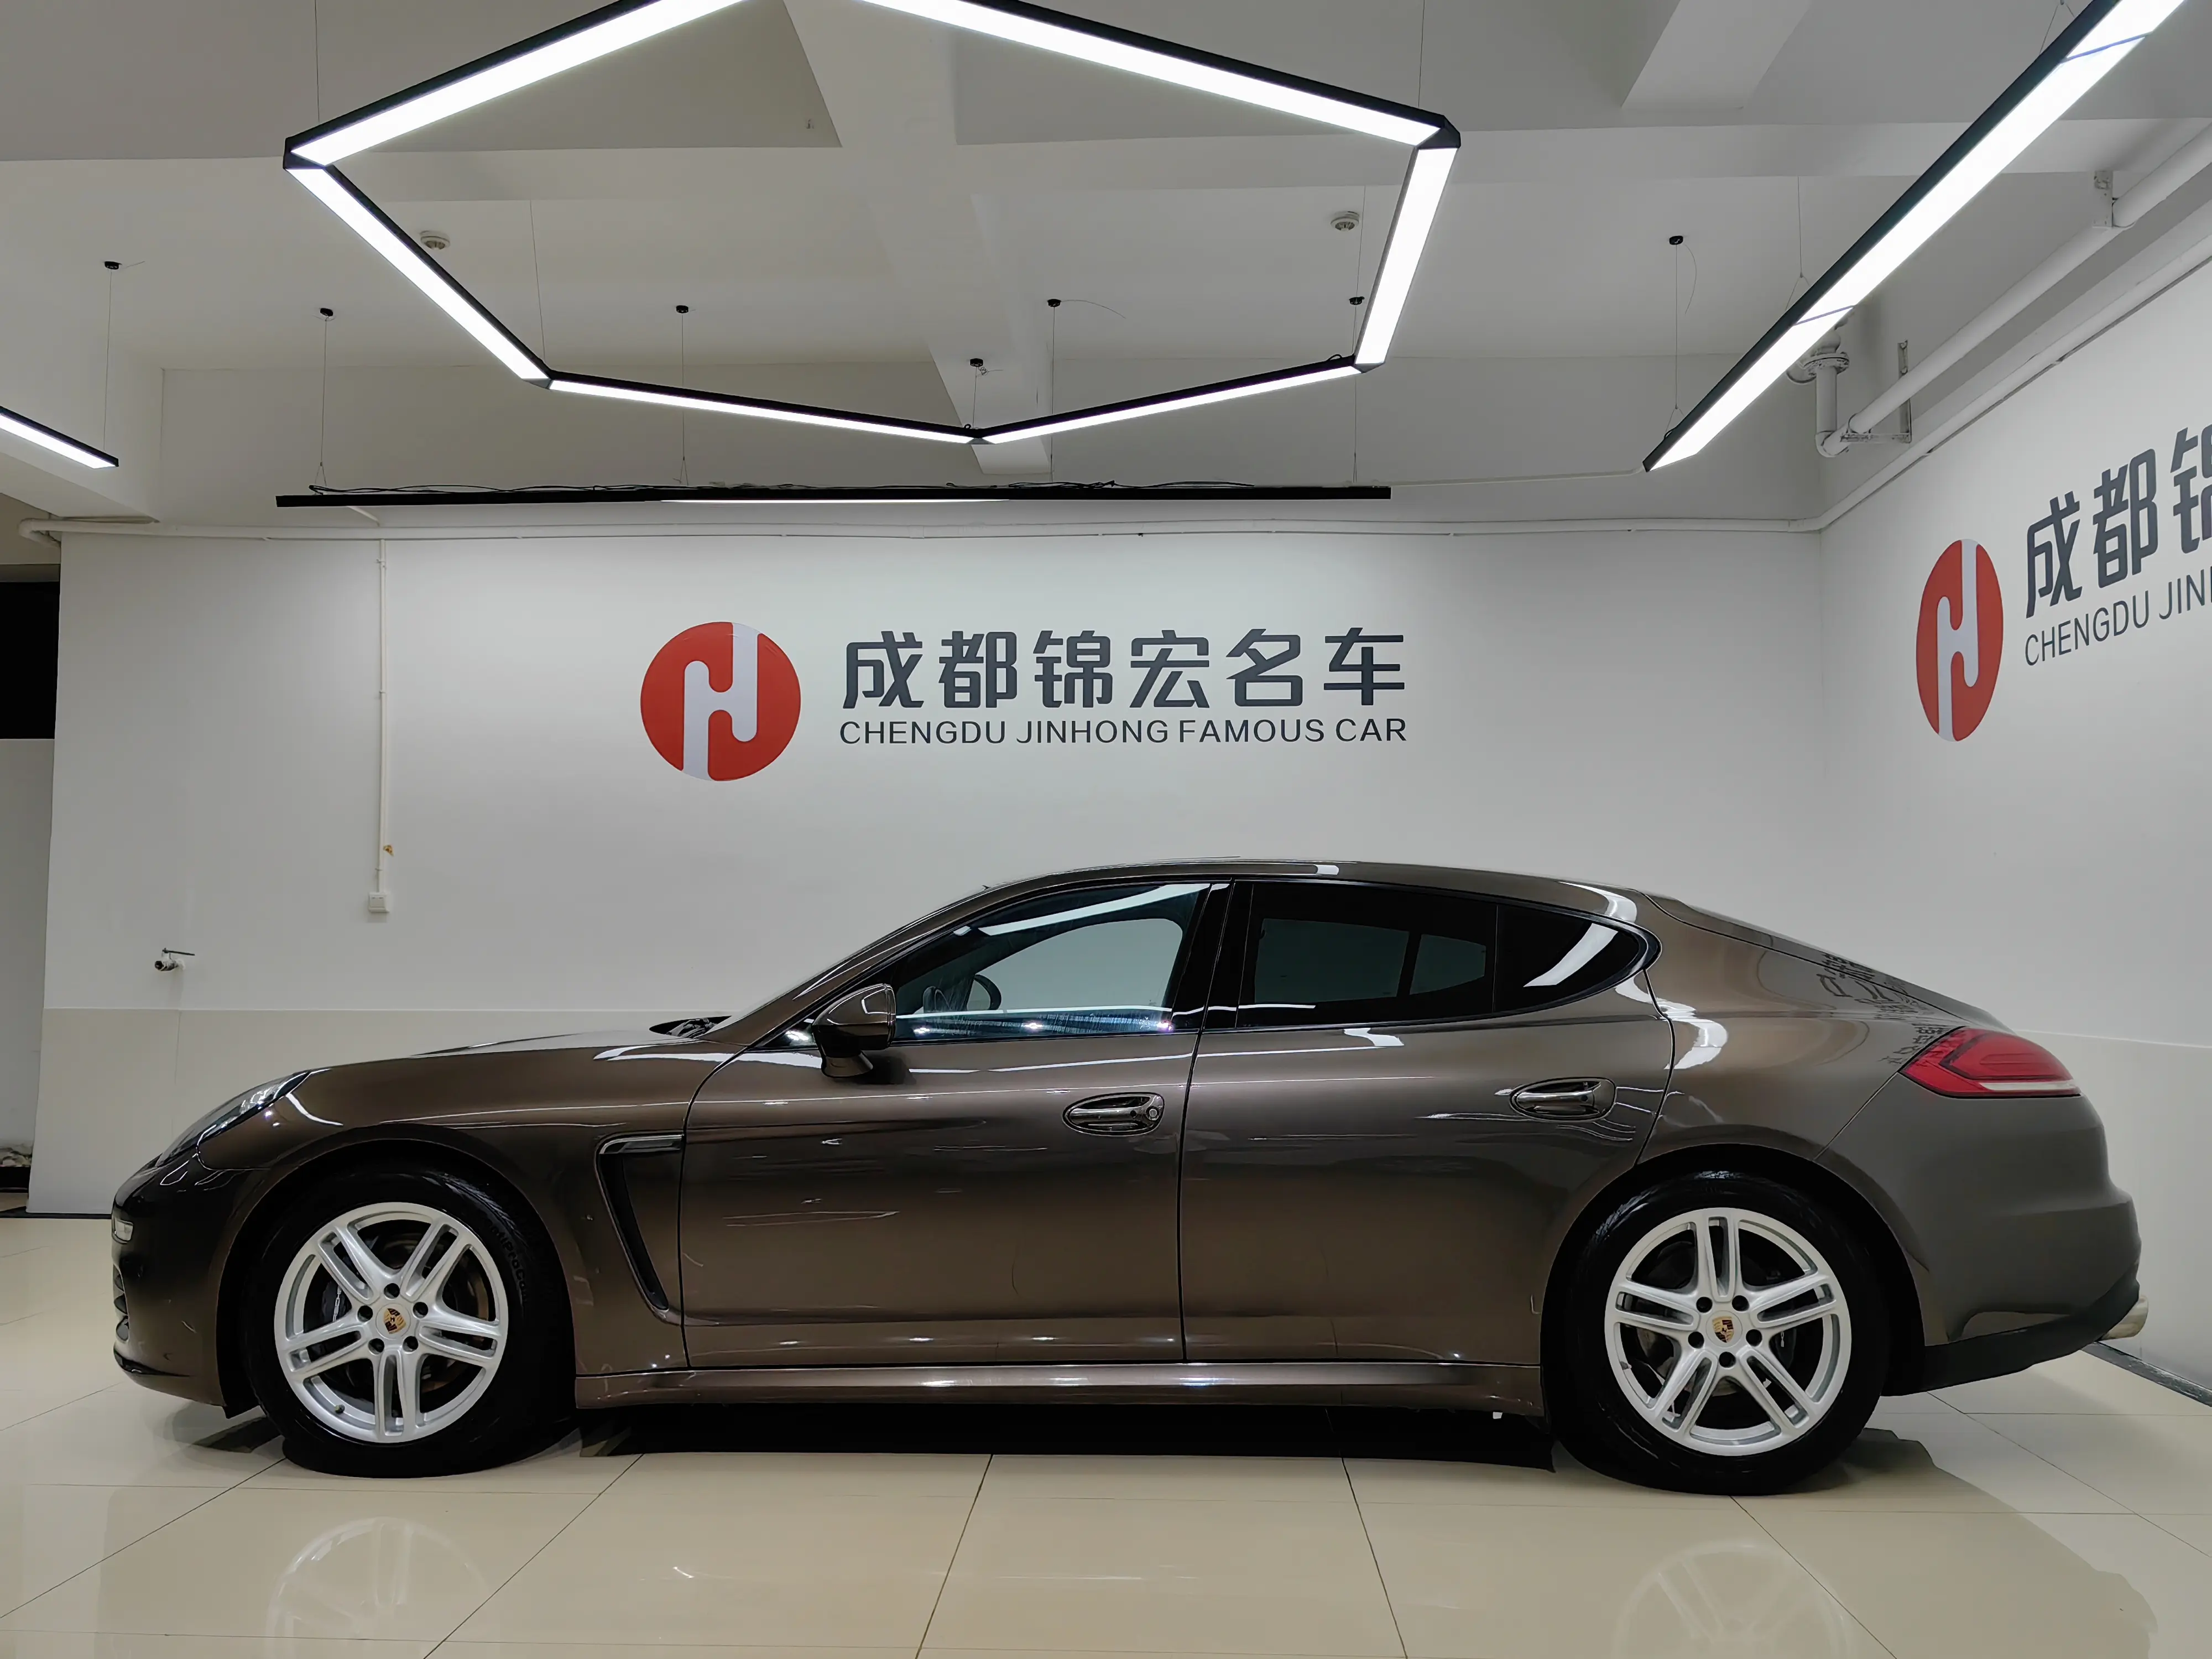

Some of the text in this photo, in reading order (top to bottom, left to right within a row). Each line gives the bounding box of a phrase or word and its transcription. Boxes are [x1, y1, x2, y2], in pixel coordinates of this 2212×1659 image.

[2025, 566, 2212, 666] CHENGDU JIN
[842, 627, 1405, 709] 成都锦宏名车
[840, 718, 1407, 744] CHENGDU JINHONG FAMOUS CAR
